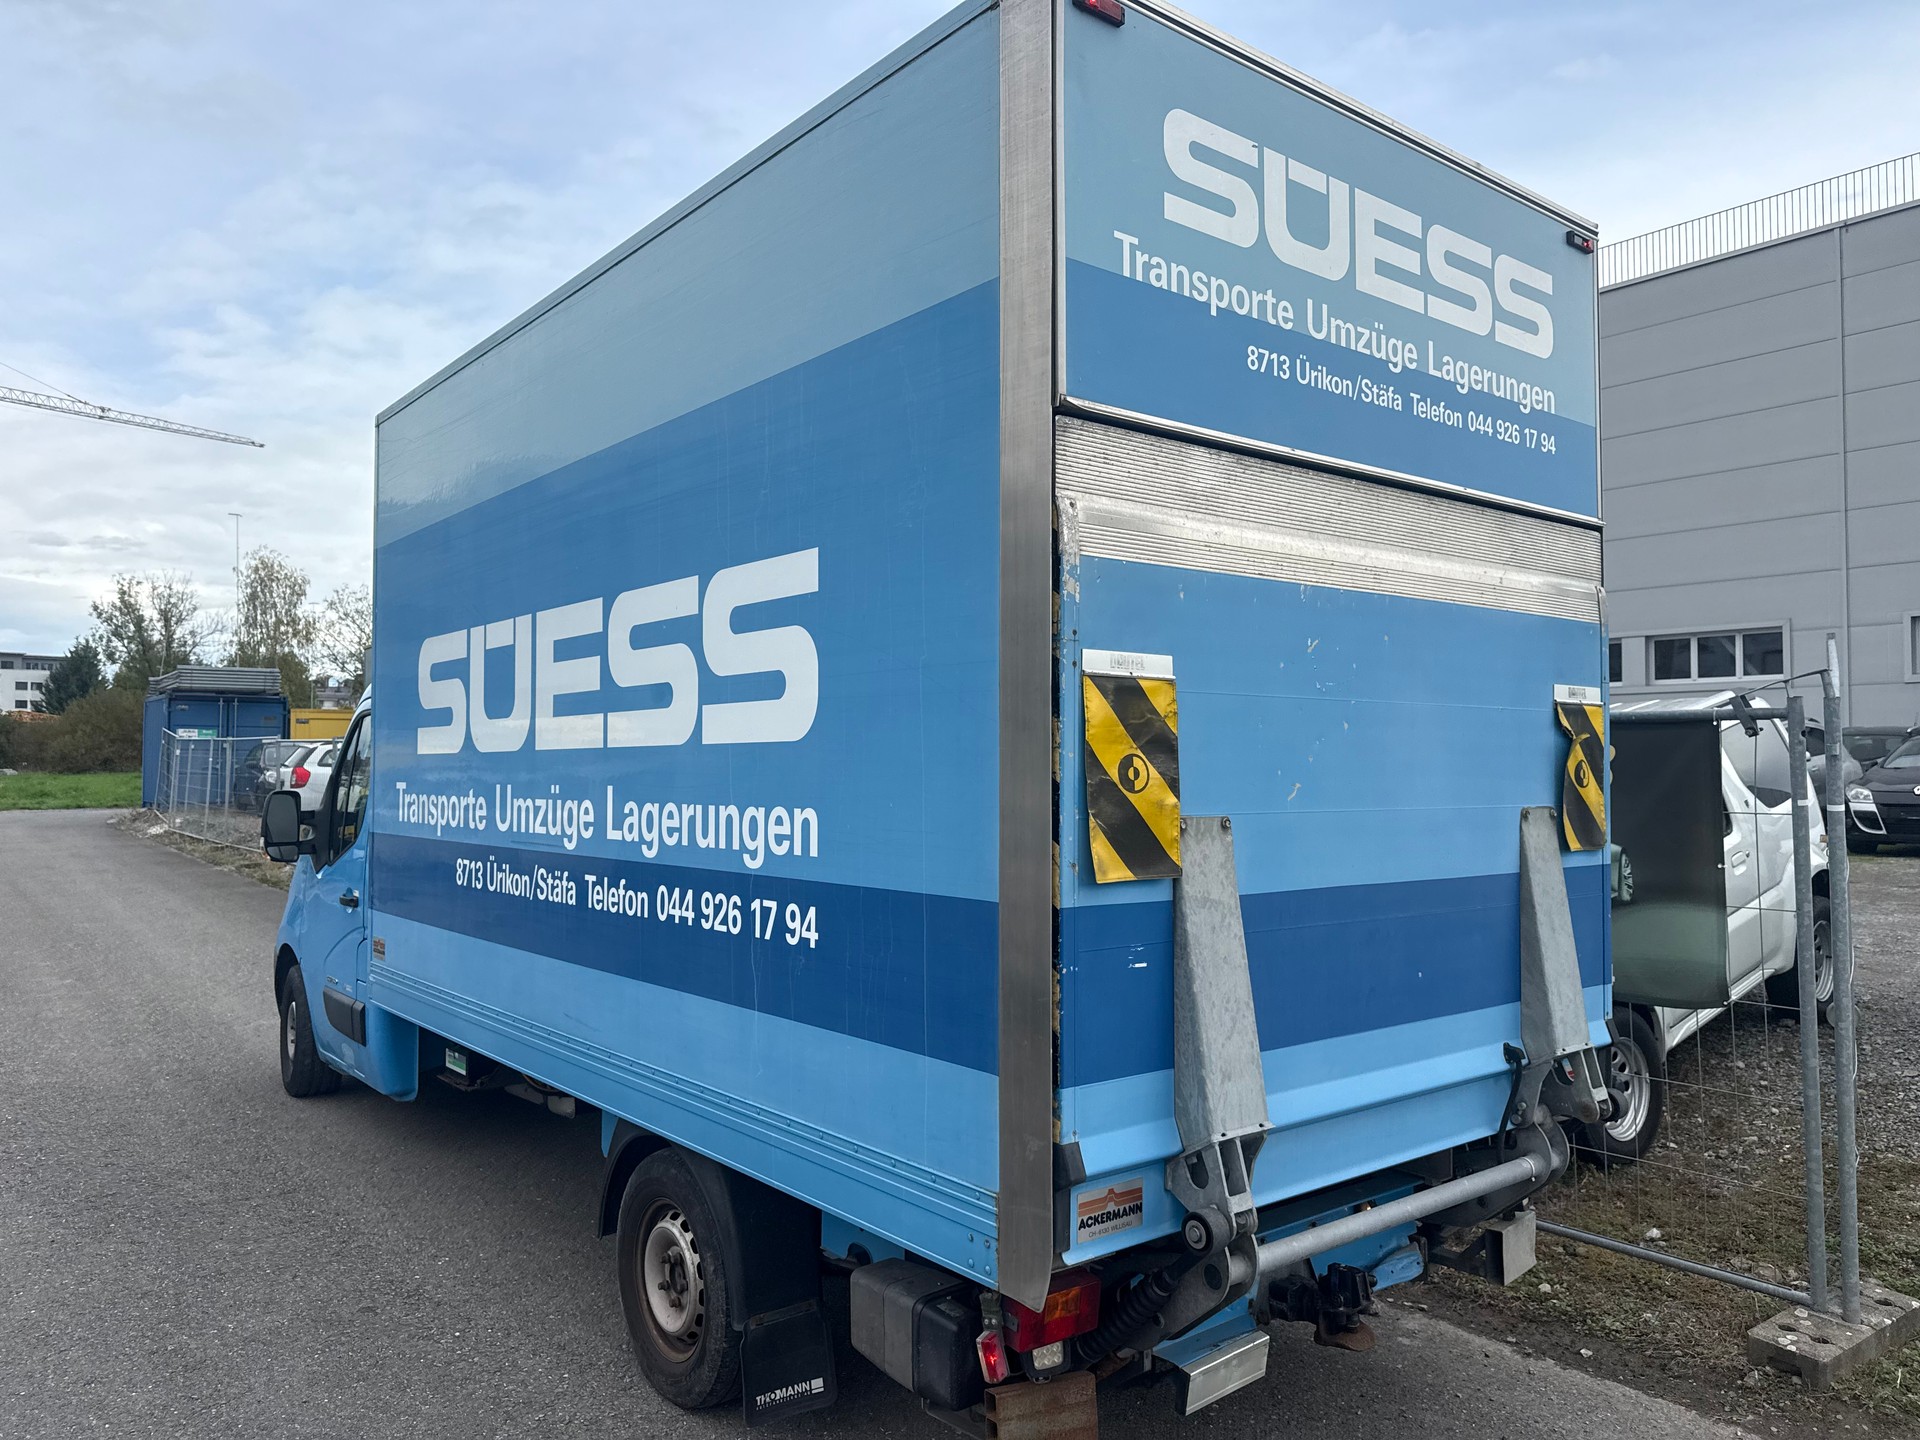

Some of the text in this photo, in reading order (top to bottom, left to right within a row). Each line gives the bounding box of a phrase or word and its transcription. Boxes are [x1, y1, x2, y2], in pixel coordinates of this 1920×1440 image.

[1163, 108, 1554, 360] SÜESS
[1113, 230, 1556, 415] Transporte Umzüge Lagerungen
[1247, 345, 1556, 455] 8713 Ürikon/Stäfa Telefon 044 926 17 94
[417, 547, 819, 755] SÜESS
[396, 782, 819, 870] Transporte Umzüge Lagerungen
[456, 856, 819, 949] 8713 Ürikon/Stäfa Telefon 044 926 17 94
[1078, 1202, 1142, 1230] ACKERMANN
[756, 1380, 810, 1405] THOMANN
